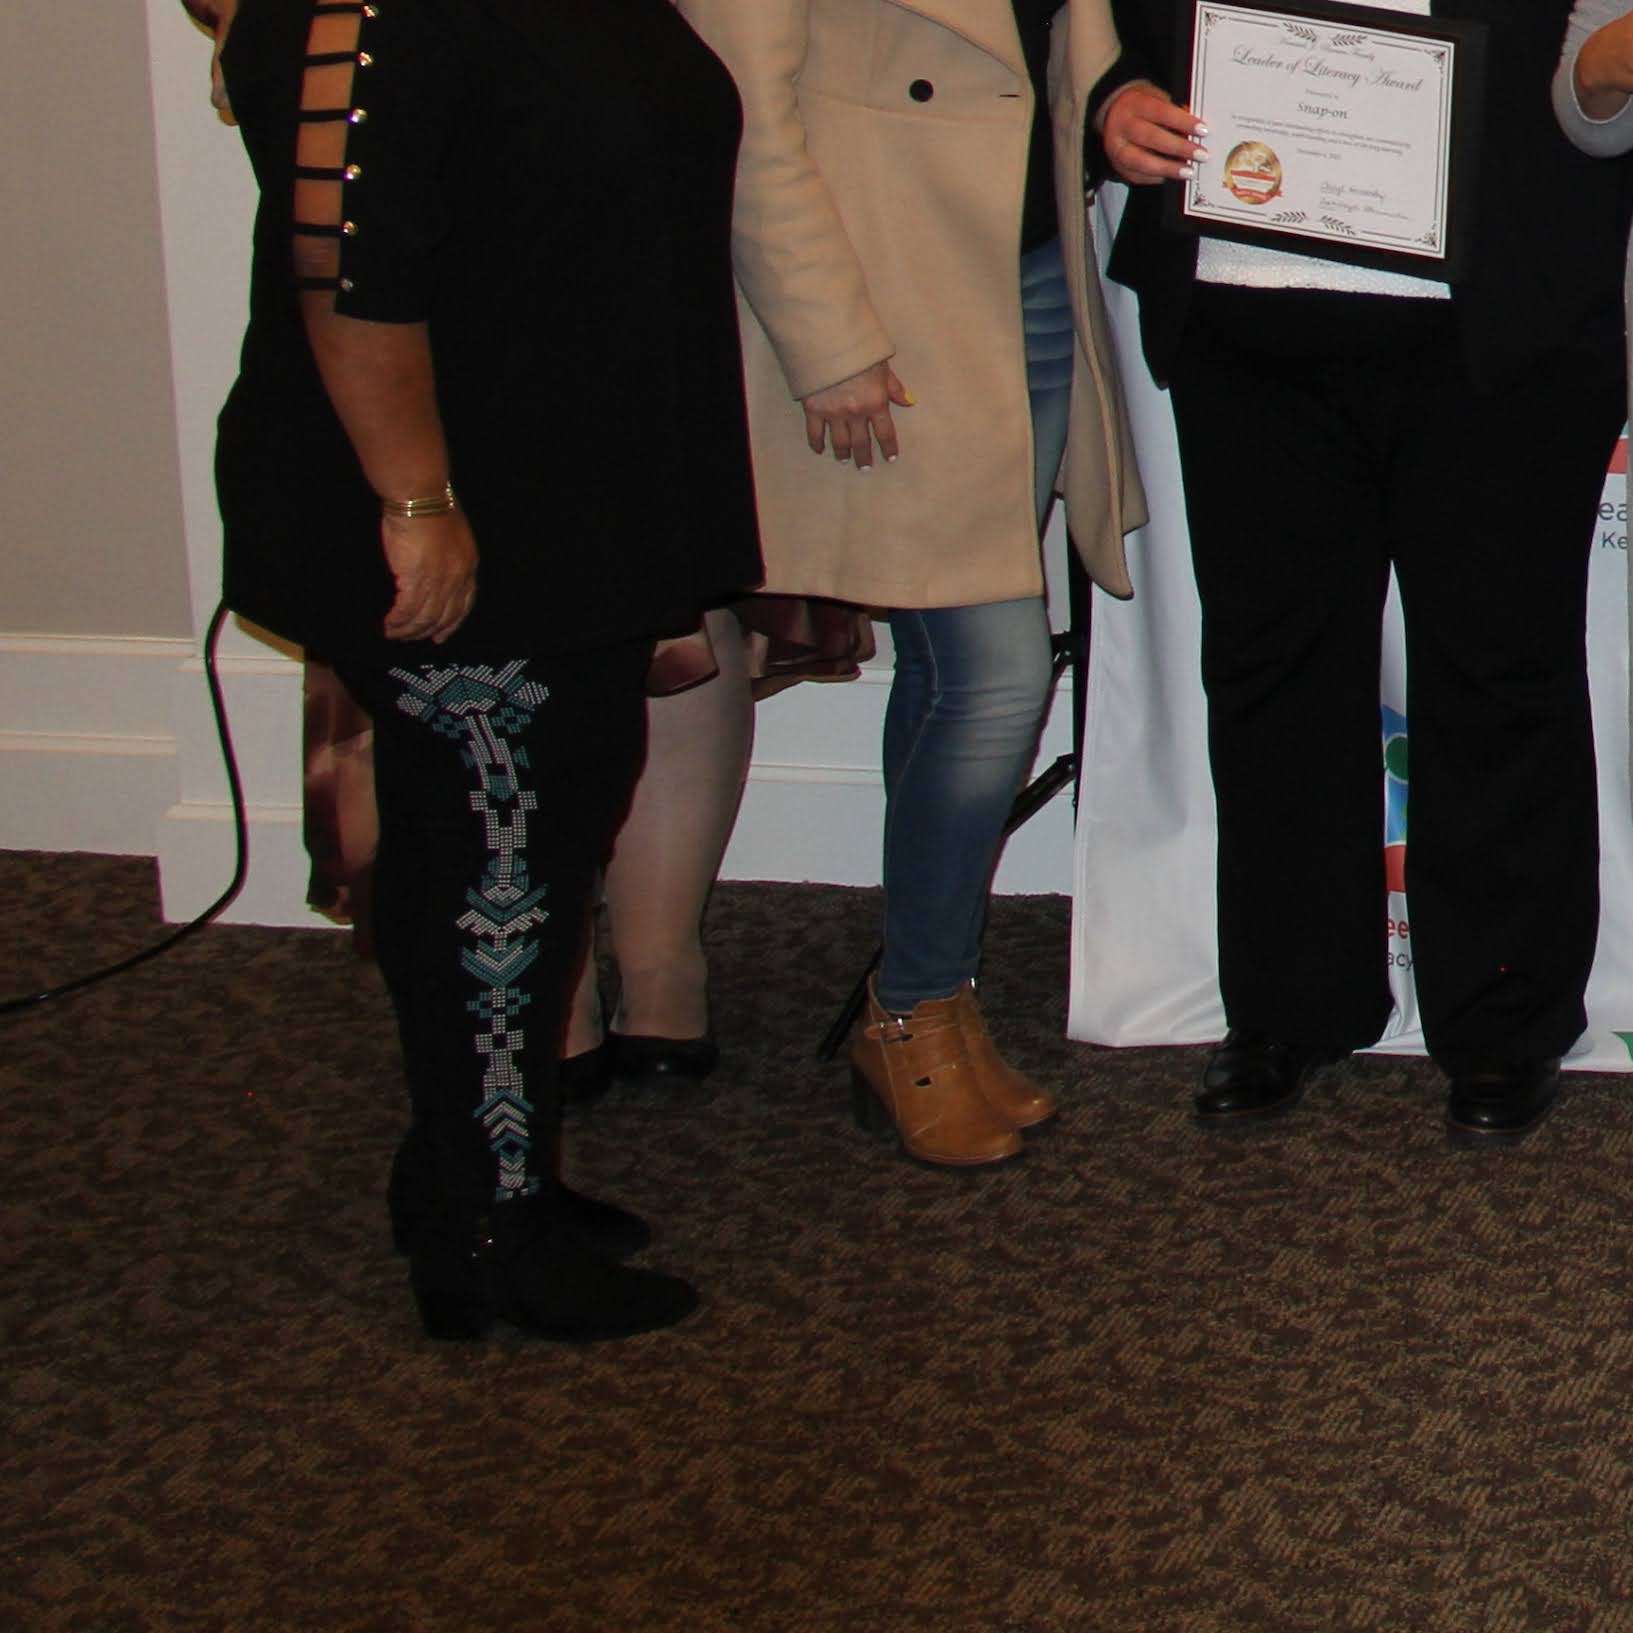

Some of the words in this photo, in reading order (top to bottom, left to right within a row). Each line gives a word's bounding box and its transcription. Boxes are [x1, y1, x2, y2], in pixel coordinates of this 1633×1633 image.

[1231, 43, 1284, 69] Leader
[1286, 60, 1302, 75] of
[1302, 55, 1361, 87] Literacy
[1365, 67, 1424, 93] Award
